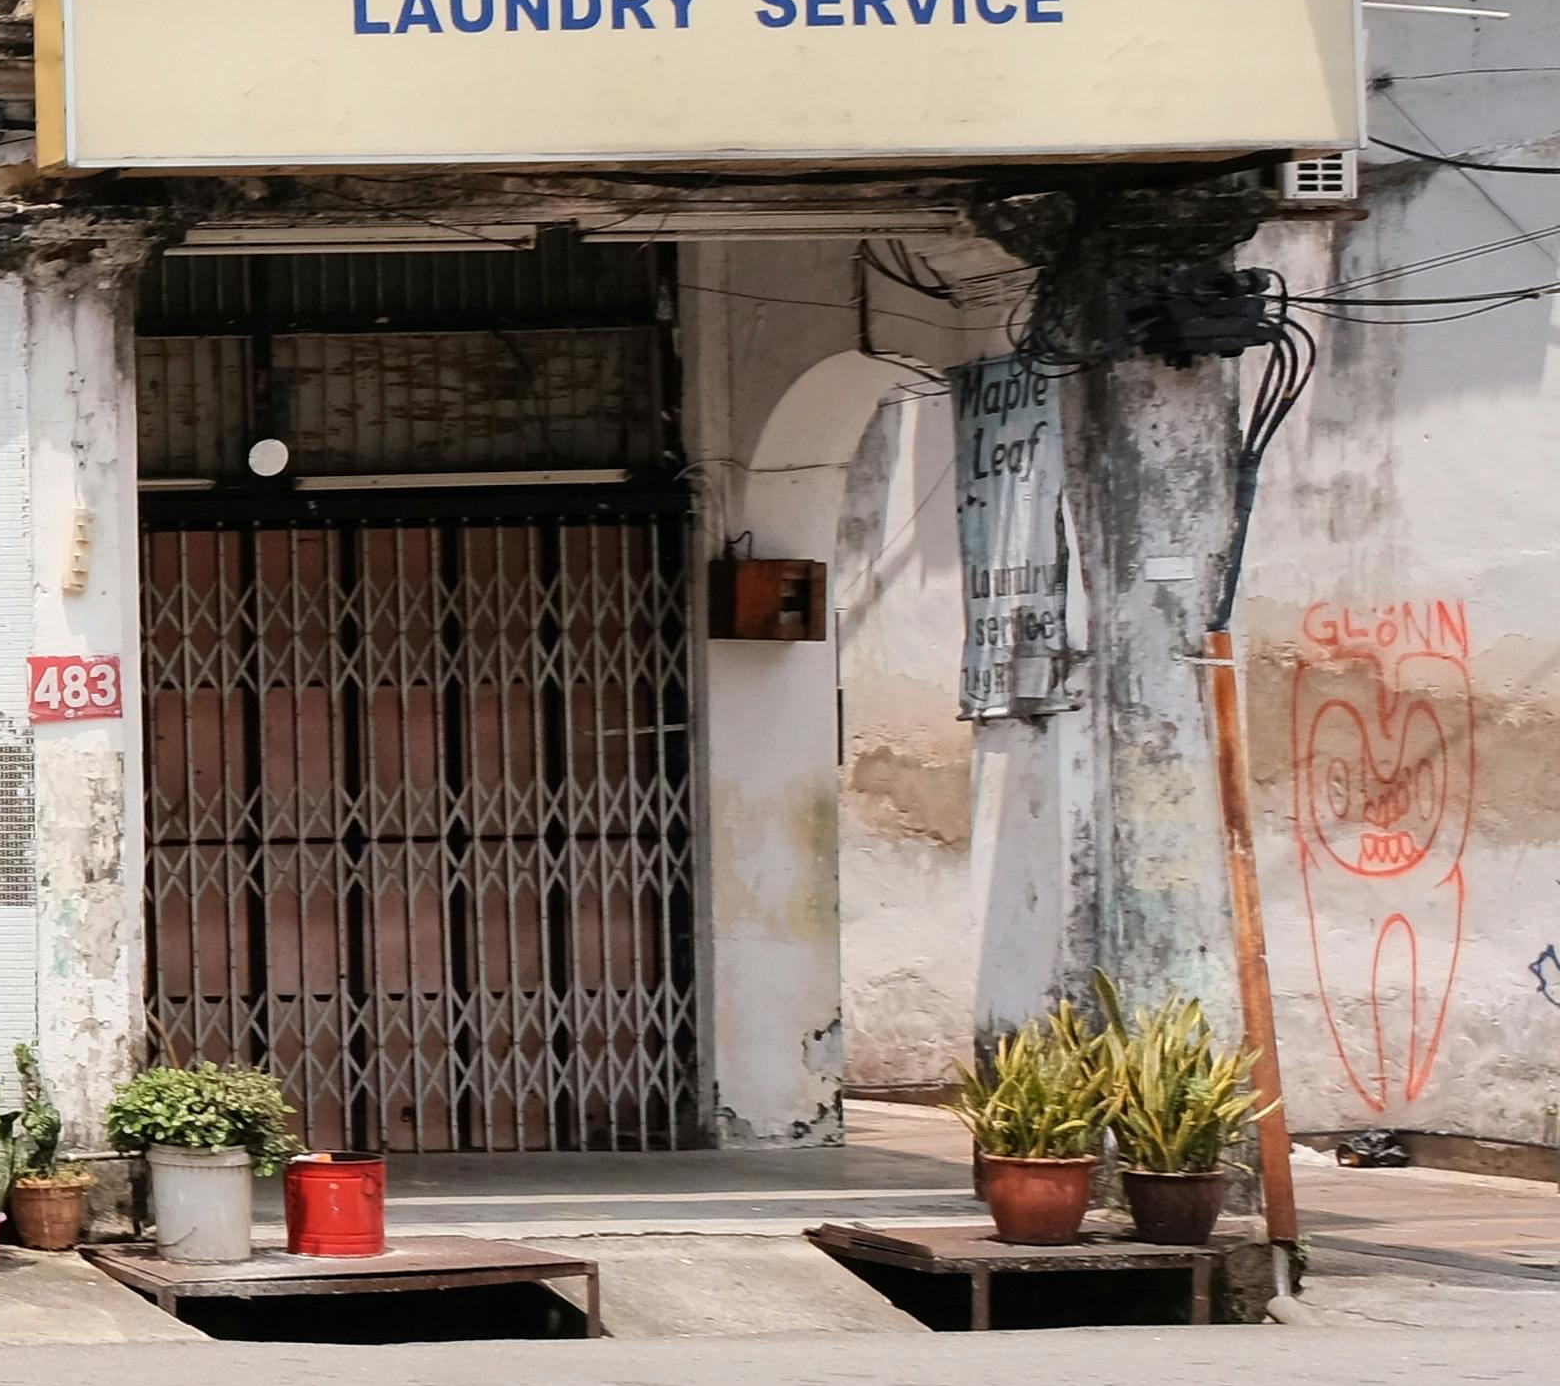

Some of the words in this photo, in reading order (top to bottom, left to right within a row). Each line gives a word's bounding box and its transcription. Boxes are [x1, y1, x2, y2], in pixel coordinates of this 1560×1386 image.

[959, 362, 1049, 426] Maple
[973, 421, 1048, 481] Leaf
[33, 664, 116, 711] 483
